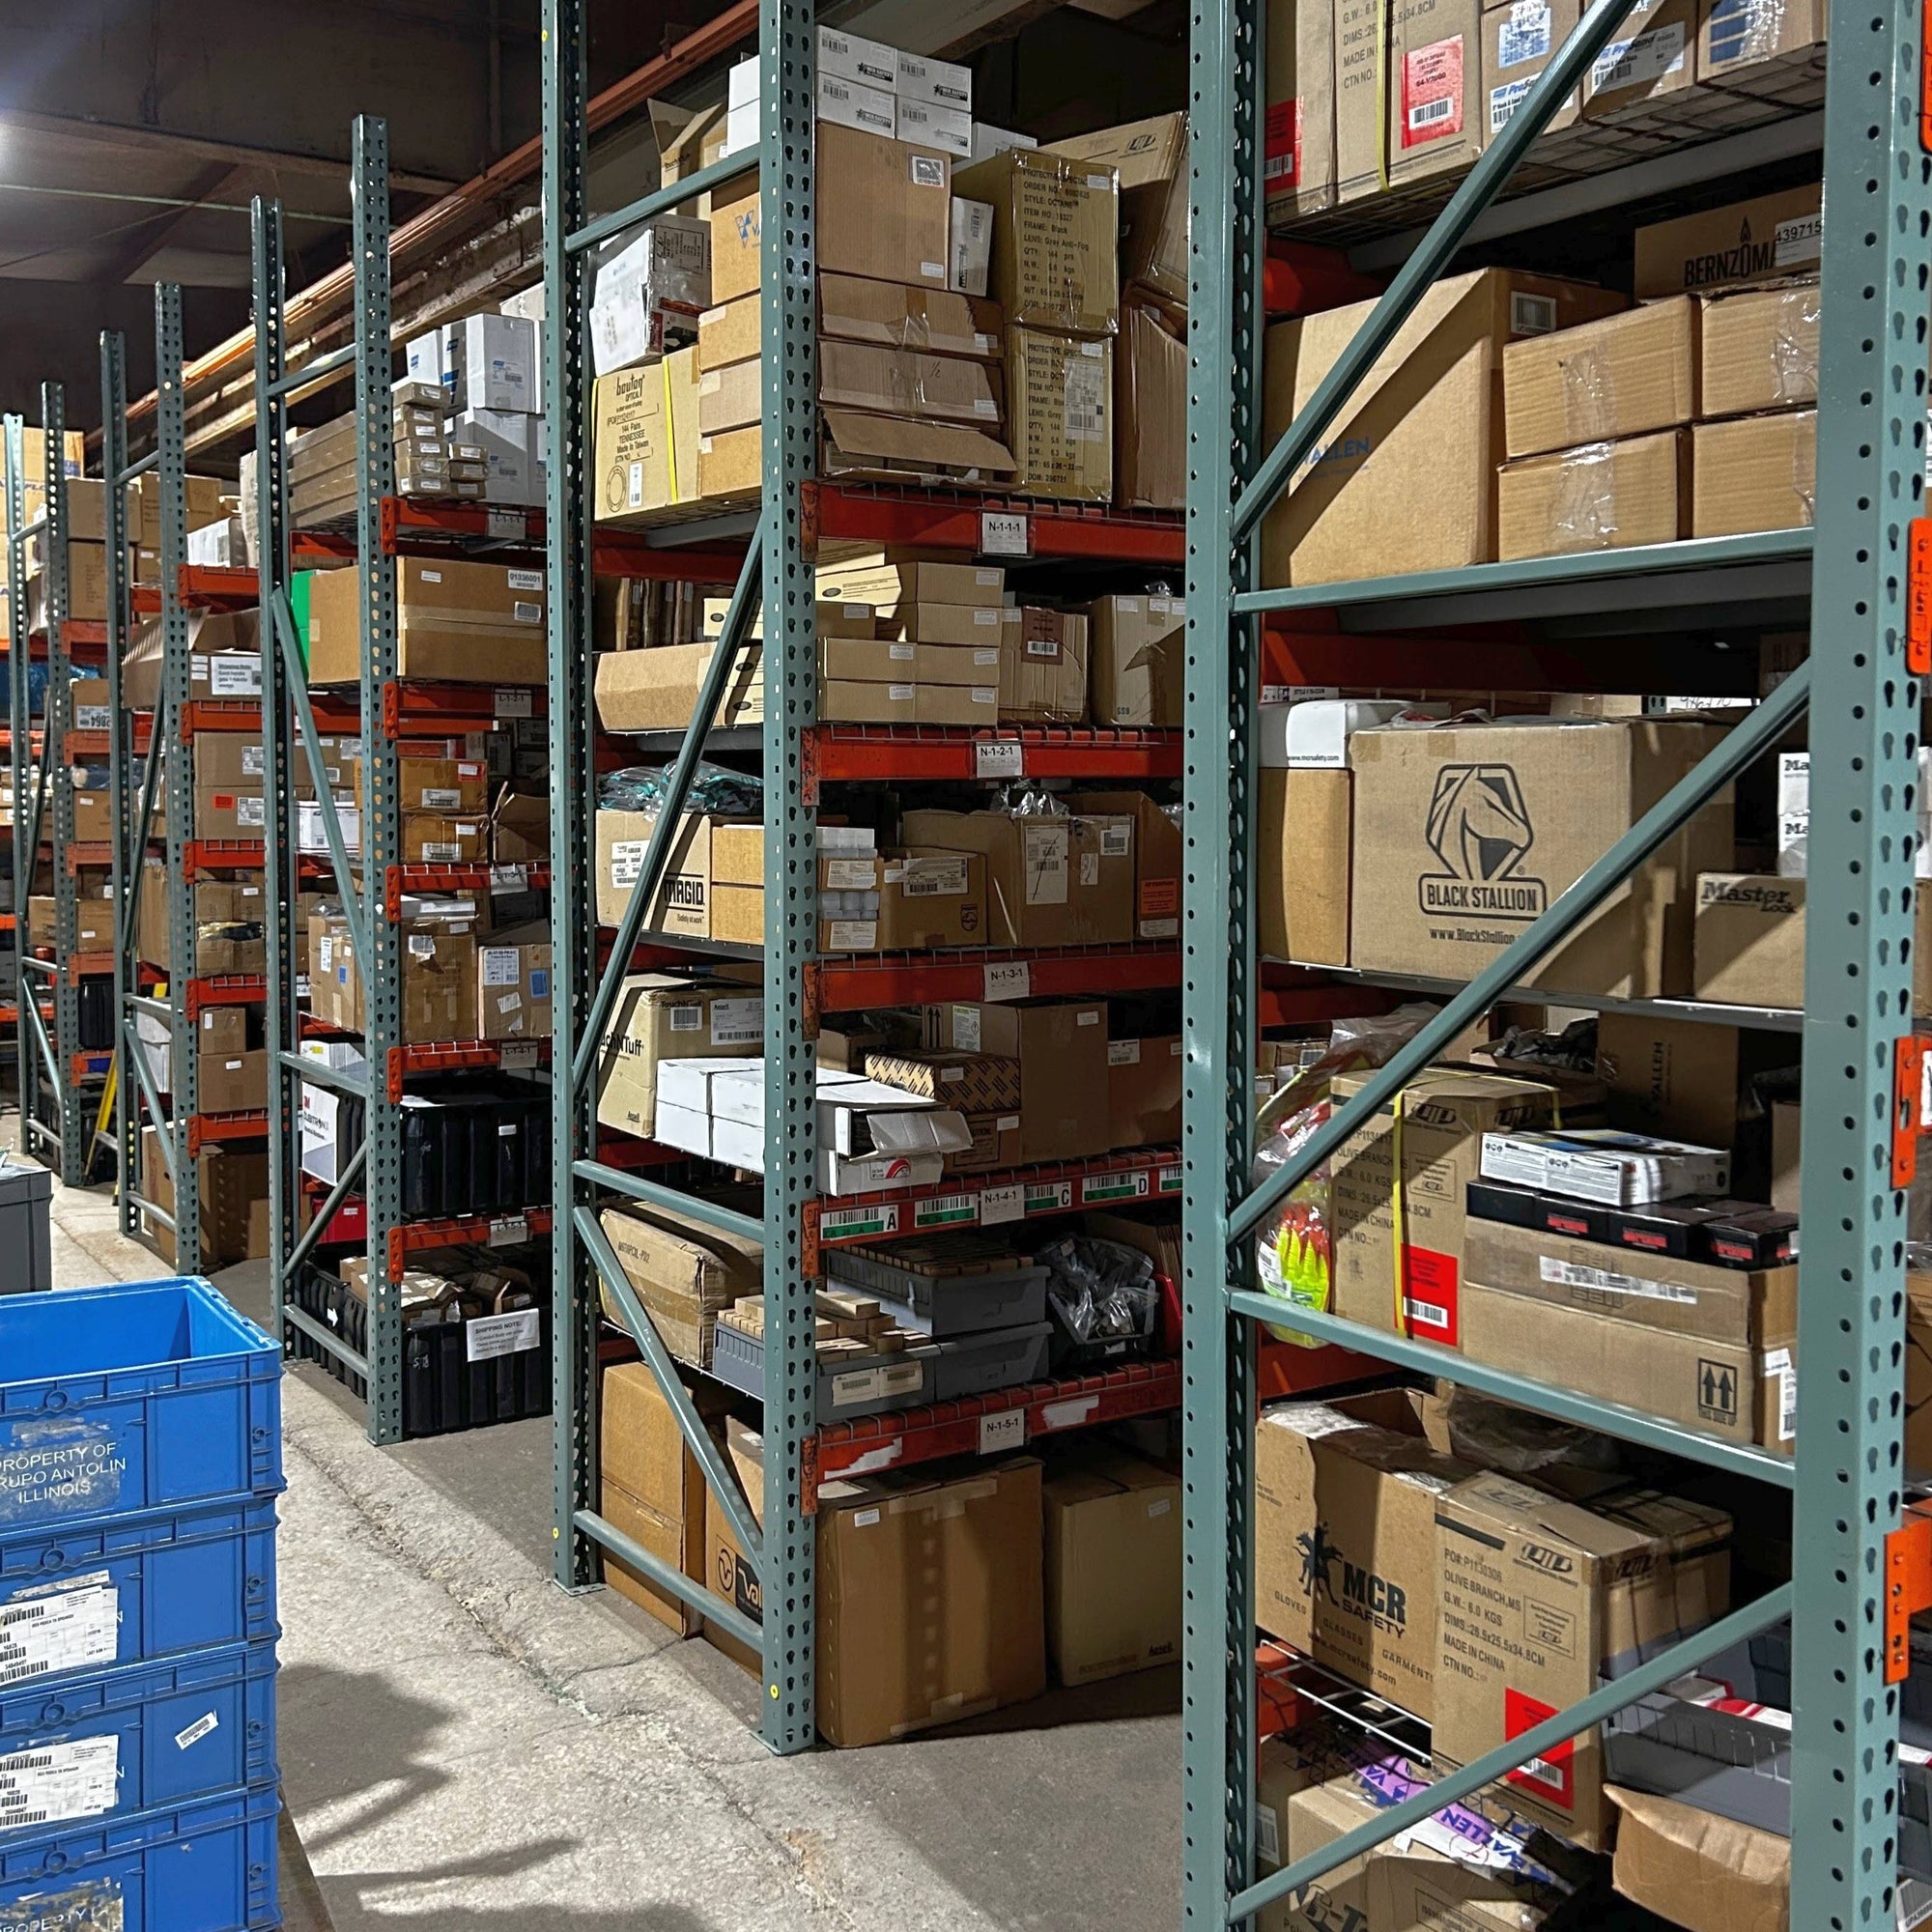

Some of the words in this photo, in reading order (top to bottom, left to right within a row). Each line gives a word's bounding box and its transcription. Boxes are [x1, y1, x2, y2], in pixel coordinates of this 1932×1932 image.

[1343, 48, 1366, 68] MADE
[1343, 72, 1360, 89] CTN
[1305, 435, 1371, 465] ALLEN
[495, 514, 521, 525] L-1-1-1
[988, 521, 1020, 531] N-1-1-1
[980, 746, 1013, 756] N-1-2-1
[1426, 883, 1469, 908] BLACK
[1471, 886, 1538, 912] STALLION
[1702, 881, 1790, 904] Master
[1760, 895, 1797, 915] Lock
[990, 967, 1023, 981] N-1-3-1
[1138, 1178, 1148, 1194] D
[984, 1190, 1017, 1204] N-1-4-1
[1061, 1188, 1069, 1206] C
[886, 1212, 897, 1231] A
[1370, 1214, 1395, 1230] CHINA
[474, 1324, 503, 1335] SHIPPING
[986, 1417, 1019, 1434] N-1-5-1
[93, 1442, 117, 1458] OF
[0, 1470, 47, 1491] RUPO
[18, 1480, 92, 1504] ILLINOIS
[1443, 1569, 1468, 1590] OLIVE
[1274, 1590, 1307, 1615] GLOVES
[1343, 1560, 1406, 1626] MCR
[1342, 1598, 1406, 1639] SAFETY
[1467, 1602, 1481, 1617] 6.0
[1484, 1608, 1503, 1627] KGS
[1322, 1617, 1364, 1647] GLASSES
[1443, 1632, 1467, 1655] MADE
[1467, 1644, 1478, 1660] IN
[1478, 1649, 1506, 1672] CHINA
[1442, 1654, 1461, 1672] CTN
